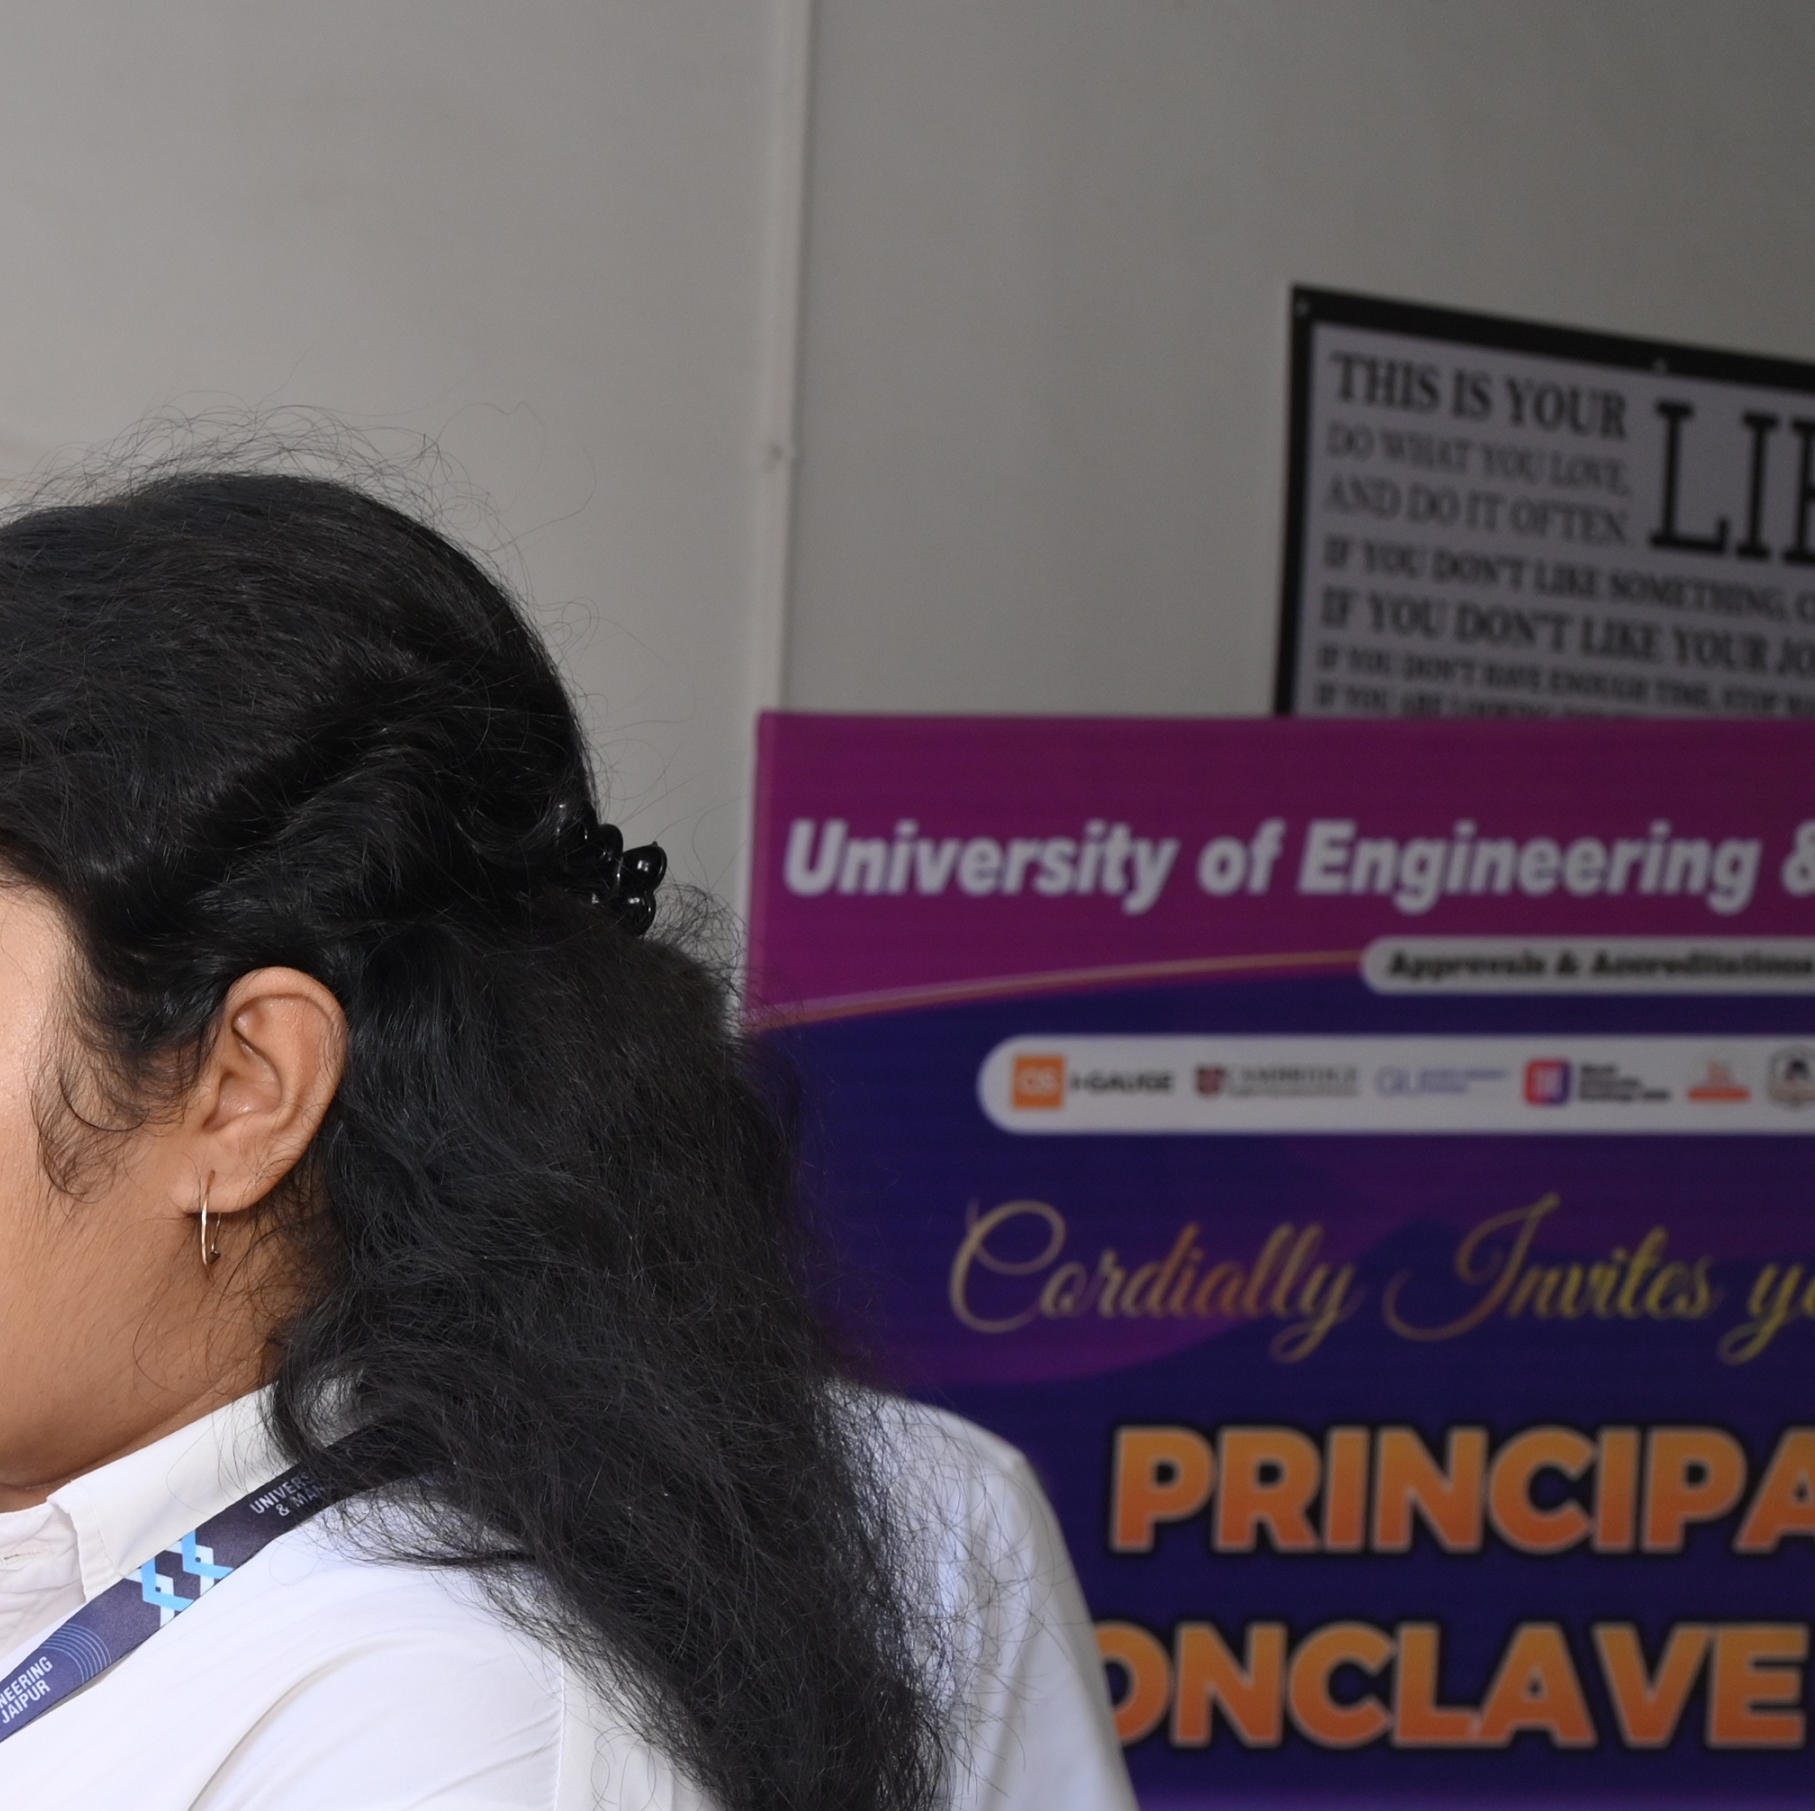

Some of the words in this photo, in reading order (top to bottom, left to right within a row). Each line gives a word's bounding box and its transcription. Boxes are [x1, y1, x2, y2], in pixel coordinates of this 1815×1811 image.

[1330, 350, 1440, 414] THIS
[1452, 367, 1492, 422] IS
[1505, 376, 1626, 441] YOUR
[1326, 419, 1374, 459] DO
[1379, 426, 1472, 474] WHAT
[1480, 441, 1546, 485] YOU
[1324, 473, 1402, 520] AND
[1406, 481, 1462, 527] DO
[1466, 490, 1503, 532] IT
[1323, 534, 1352, 572] IF
[1363, 538, 1424, 580] YOU
[1431, 546, 1527, 592] DON'T
[1534, 558, 1596, 598] LIKE
[1322, 585, 1358, 630] IF
[1369, 590, 1448, 640] YOU
[1454, 601, 1569, 654] DON'T
[1581, 613, 1662, 664] LIKE
[1673, 624, 1768, 675] YOUR
[785, 818, 1178, 914] University
[1197, 818, 1287, 895] of
[1297, 820, 1760, 914] Engineering
[1387, 950, 1544, 984] Approvals
[1555, 953, 1577, 977] &
[1590, 950, 1815, 977] Accreditations
[950, 1200, 1364, 1363] Cordially
[1383, 1192, 1722, 1341] Invites
[1108, 1424, 1815, 1555] PRINCIPA
[1, 1679, 52, 1725] JAIPUR
[1095, 1619, 1809, 1751] ONCLAVE
